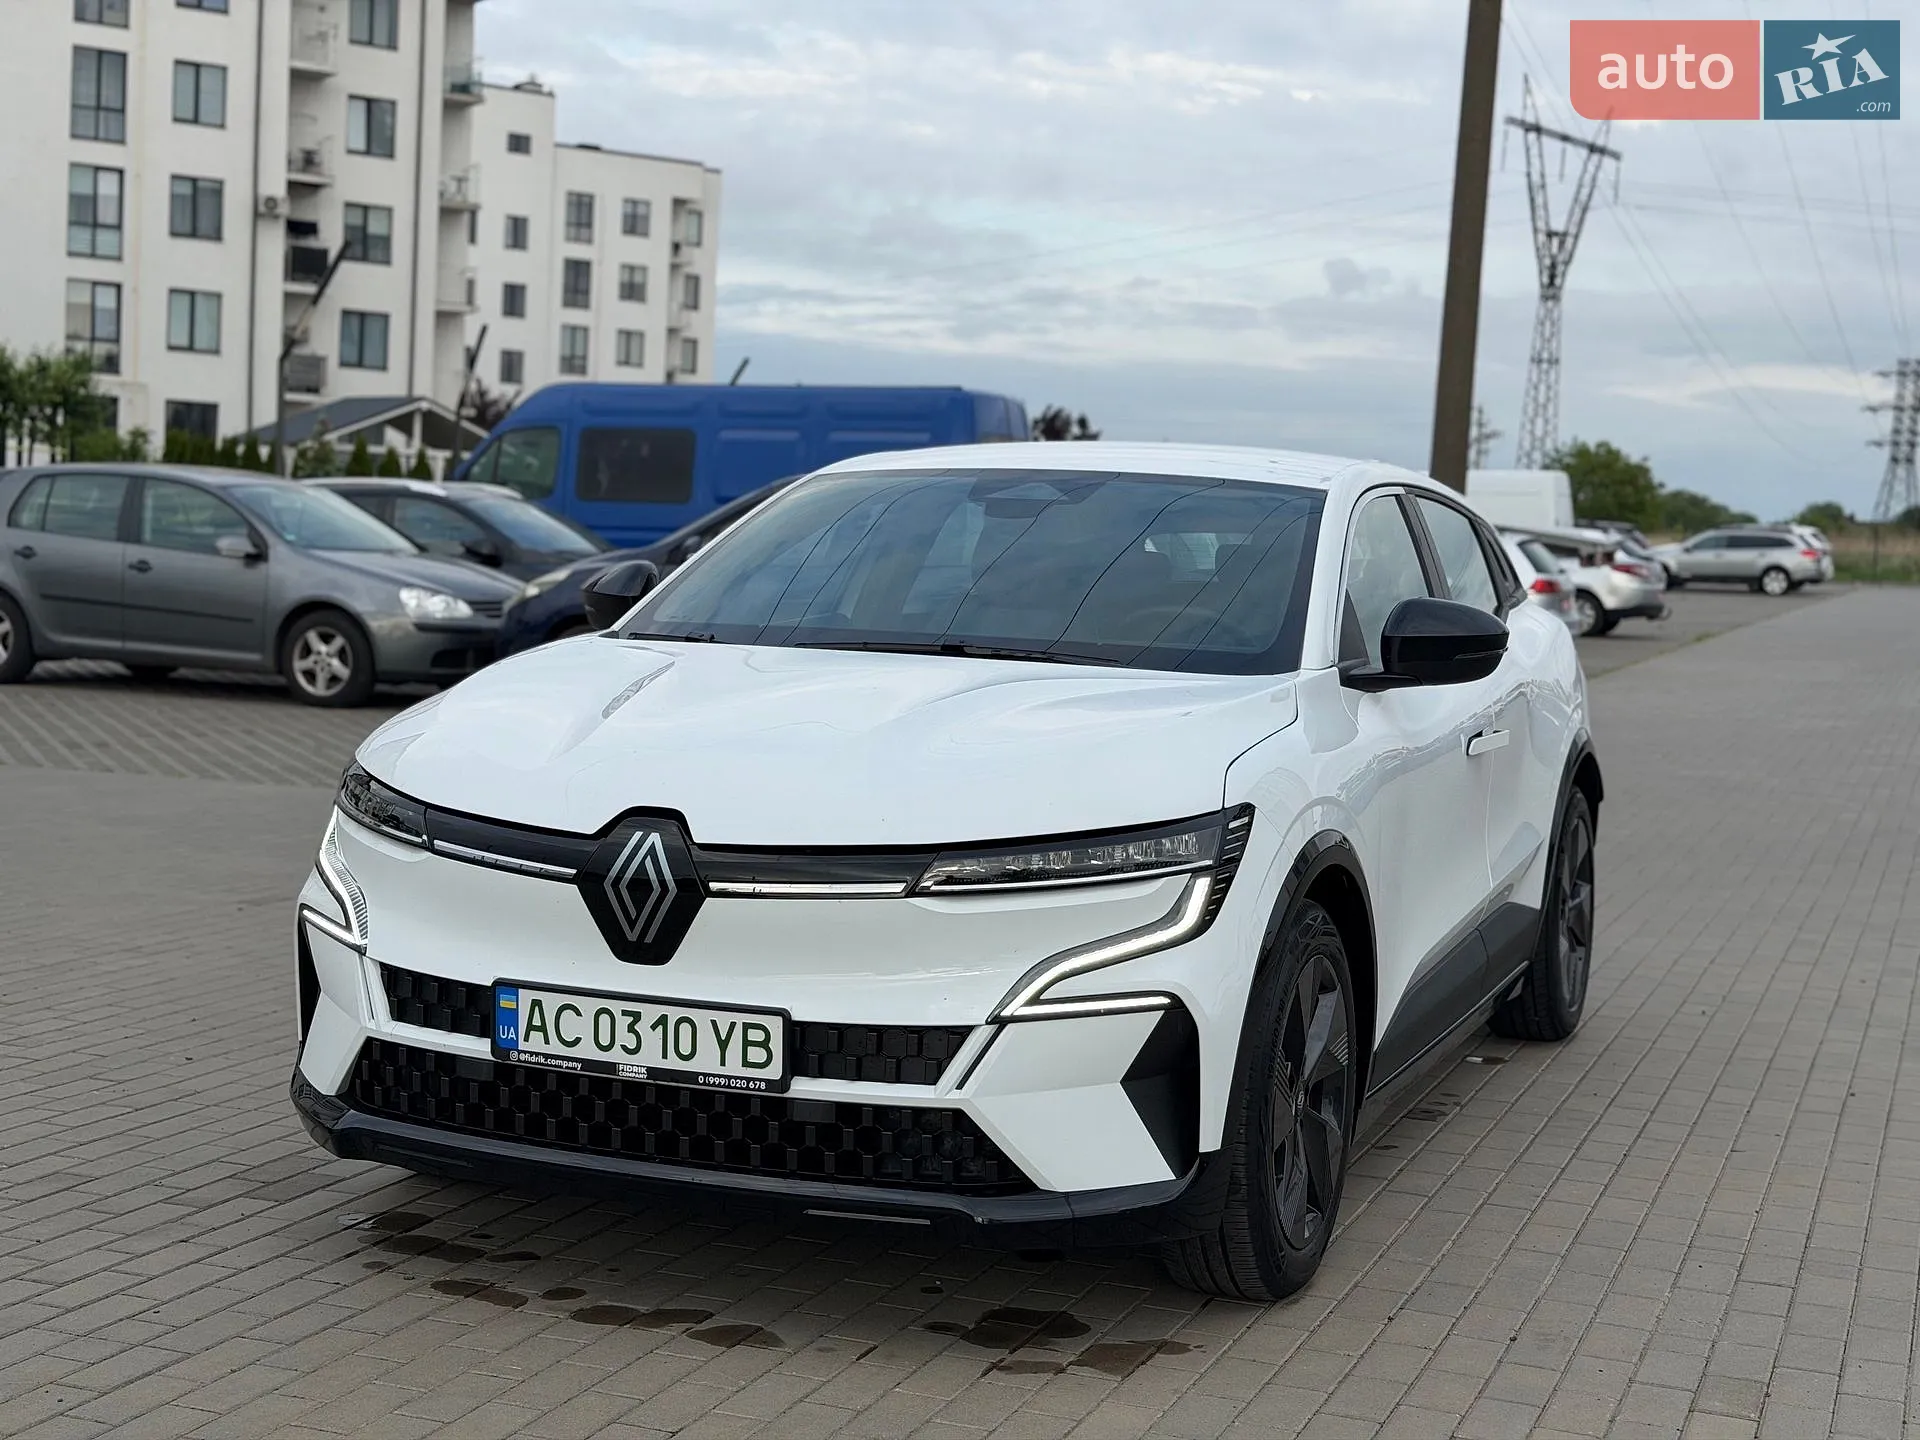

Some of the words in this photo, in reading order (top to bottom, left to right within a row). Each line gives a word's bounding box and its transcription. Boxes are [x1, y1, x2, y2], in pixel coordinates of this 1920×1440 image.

[499, 1024, 517, 1041] UA
[523, 998, 583, 1048] AC
[593, 1006, 698, 1062] 0310
[709, 1019, 774, 1070] YB
[519, 1052, 582, 1071] @fidrik.company
[619, 1063, 648, 1074] FIDRIK
[618, 1070, 648, 1079] COMPANY
[698, 1075, 704, 1084] 0
[705, 1076, 729, 1087] (999)
[730, 1079, 747, 1088] 020
[748, 1081, 766, 1090] 678
